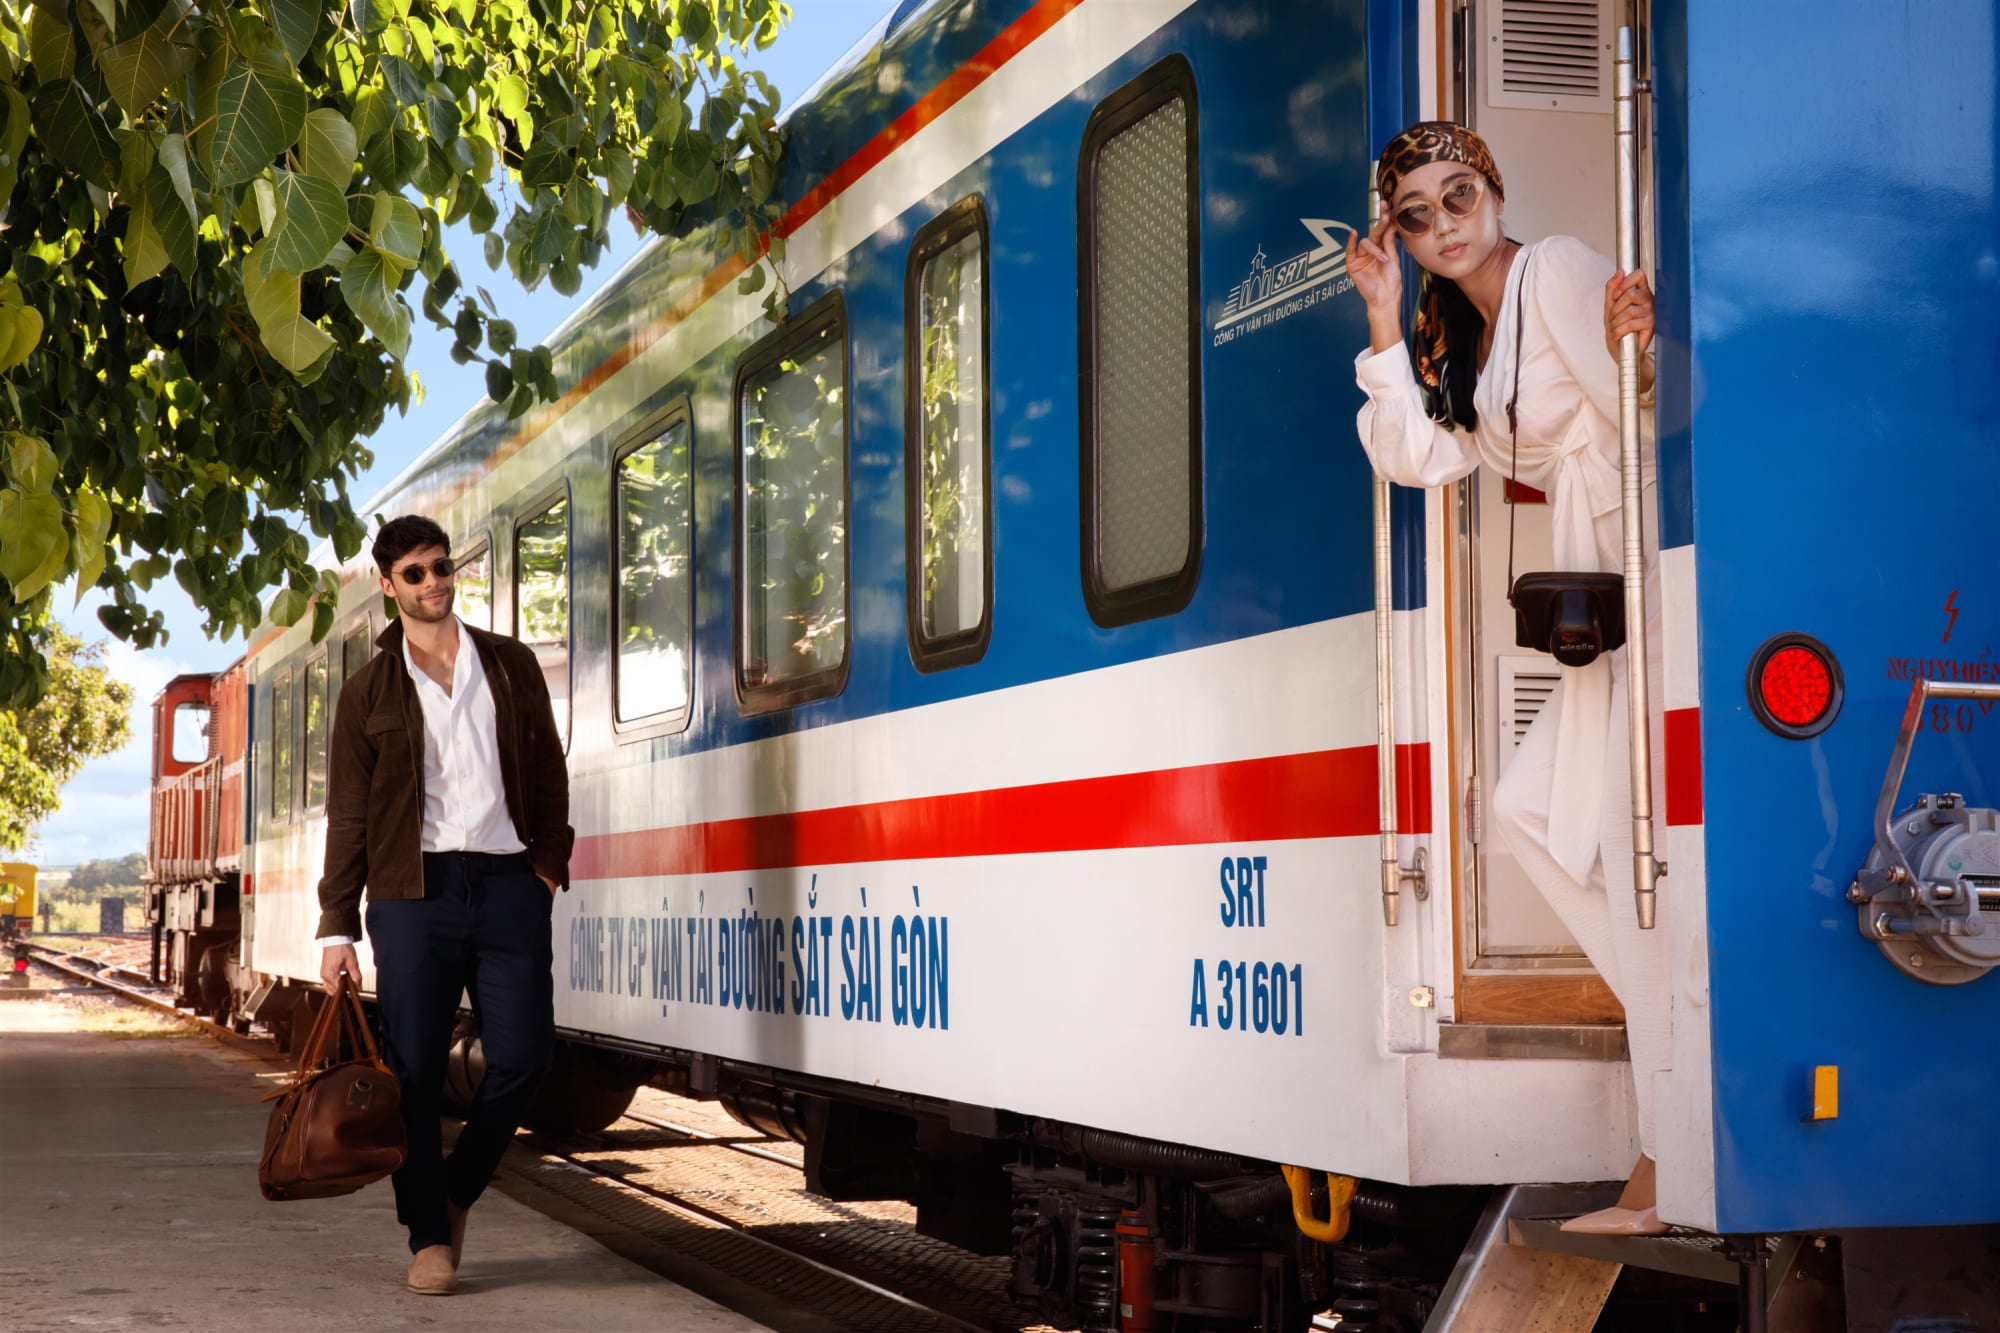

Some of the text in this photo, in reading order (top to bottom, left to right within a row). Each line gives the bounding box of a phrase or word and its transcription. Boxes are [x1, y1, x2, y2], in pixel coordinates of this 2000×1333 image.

[1274, 258, 1306, 289] SRT
[1213, 328, 1235, 347] CÔNG
[1235, 323, 1246, 338] TY
[1219, 856, 1268, 928] SRT
[570, 873, 949, 1031] CÔNG TY CP VẬN TẢI ĐƯỜNG SẮT SÀI GÒN
[1190, 958, 1303, 1037] A 31601
